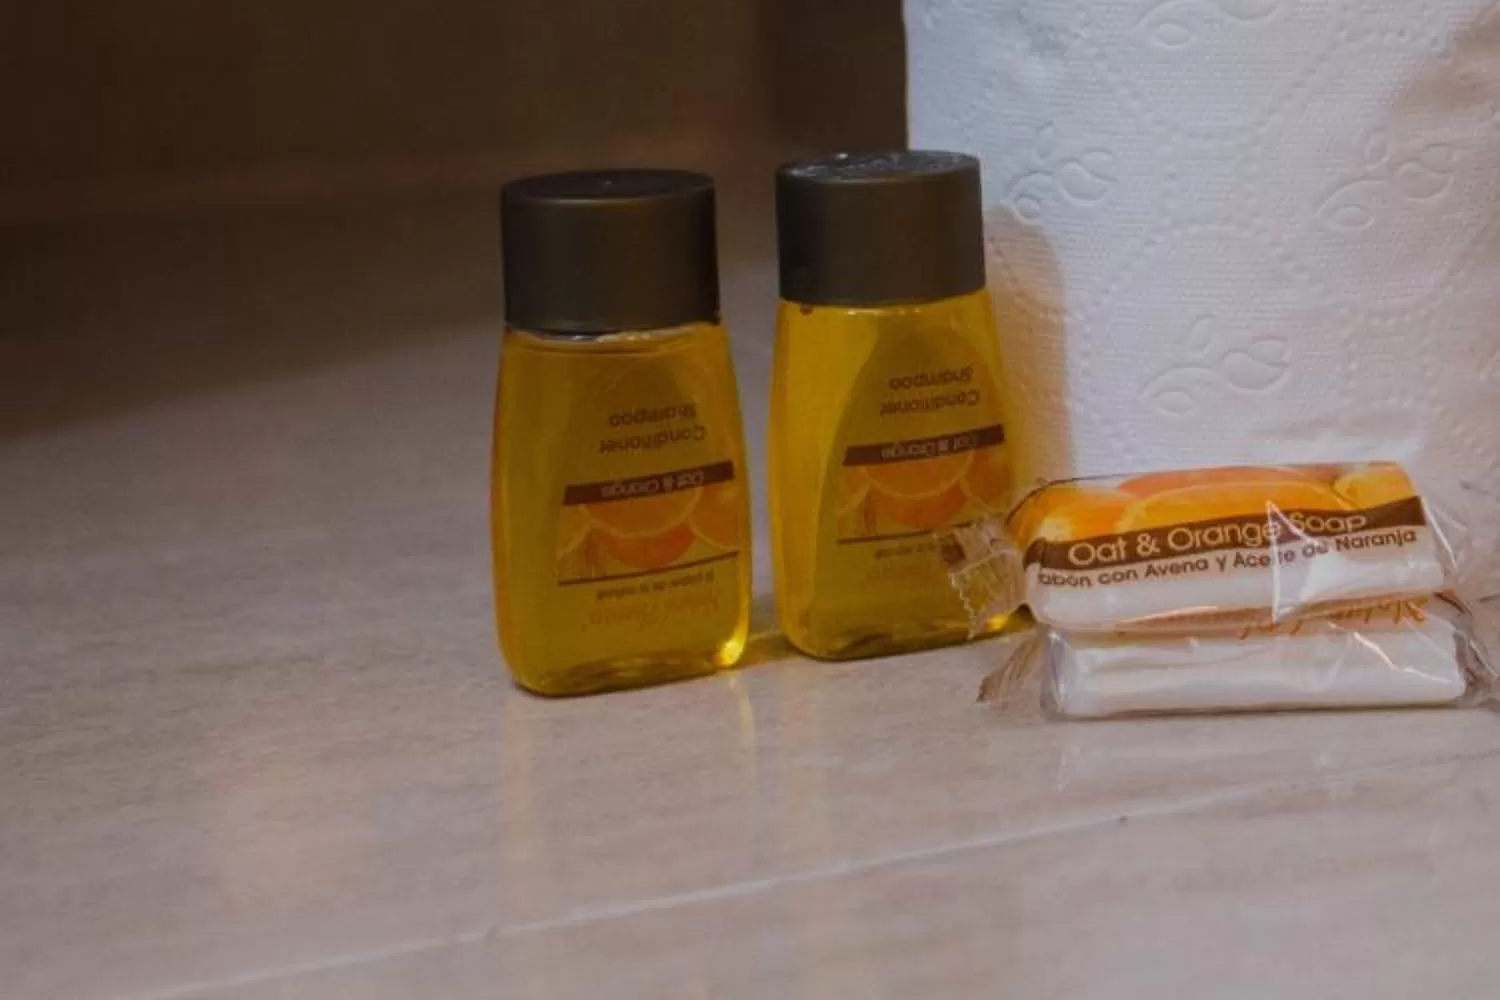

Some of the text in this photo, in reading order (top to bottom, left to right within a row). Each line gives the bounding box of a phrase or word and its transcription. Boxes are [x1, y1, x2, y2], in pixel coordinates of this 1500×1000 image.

[888, 365, 974, 390] Shampoo
[609, 403, 697, 427] Shampoo
[880, 390, 980, 417] Conditioner
[598, 425, 708, 454] Conditioner
[1068, 511, 1367, 567] Oat & Orange Soap
[1098, 568, 1138, 585] con
[1145, 555, 1209, 578] Avena
[1215, 556, 1227, 572] y
[1233, 549, 1296, 568] Acete
[1335, 528, 1418, 552] Naranja
